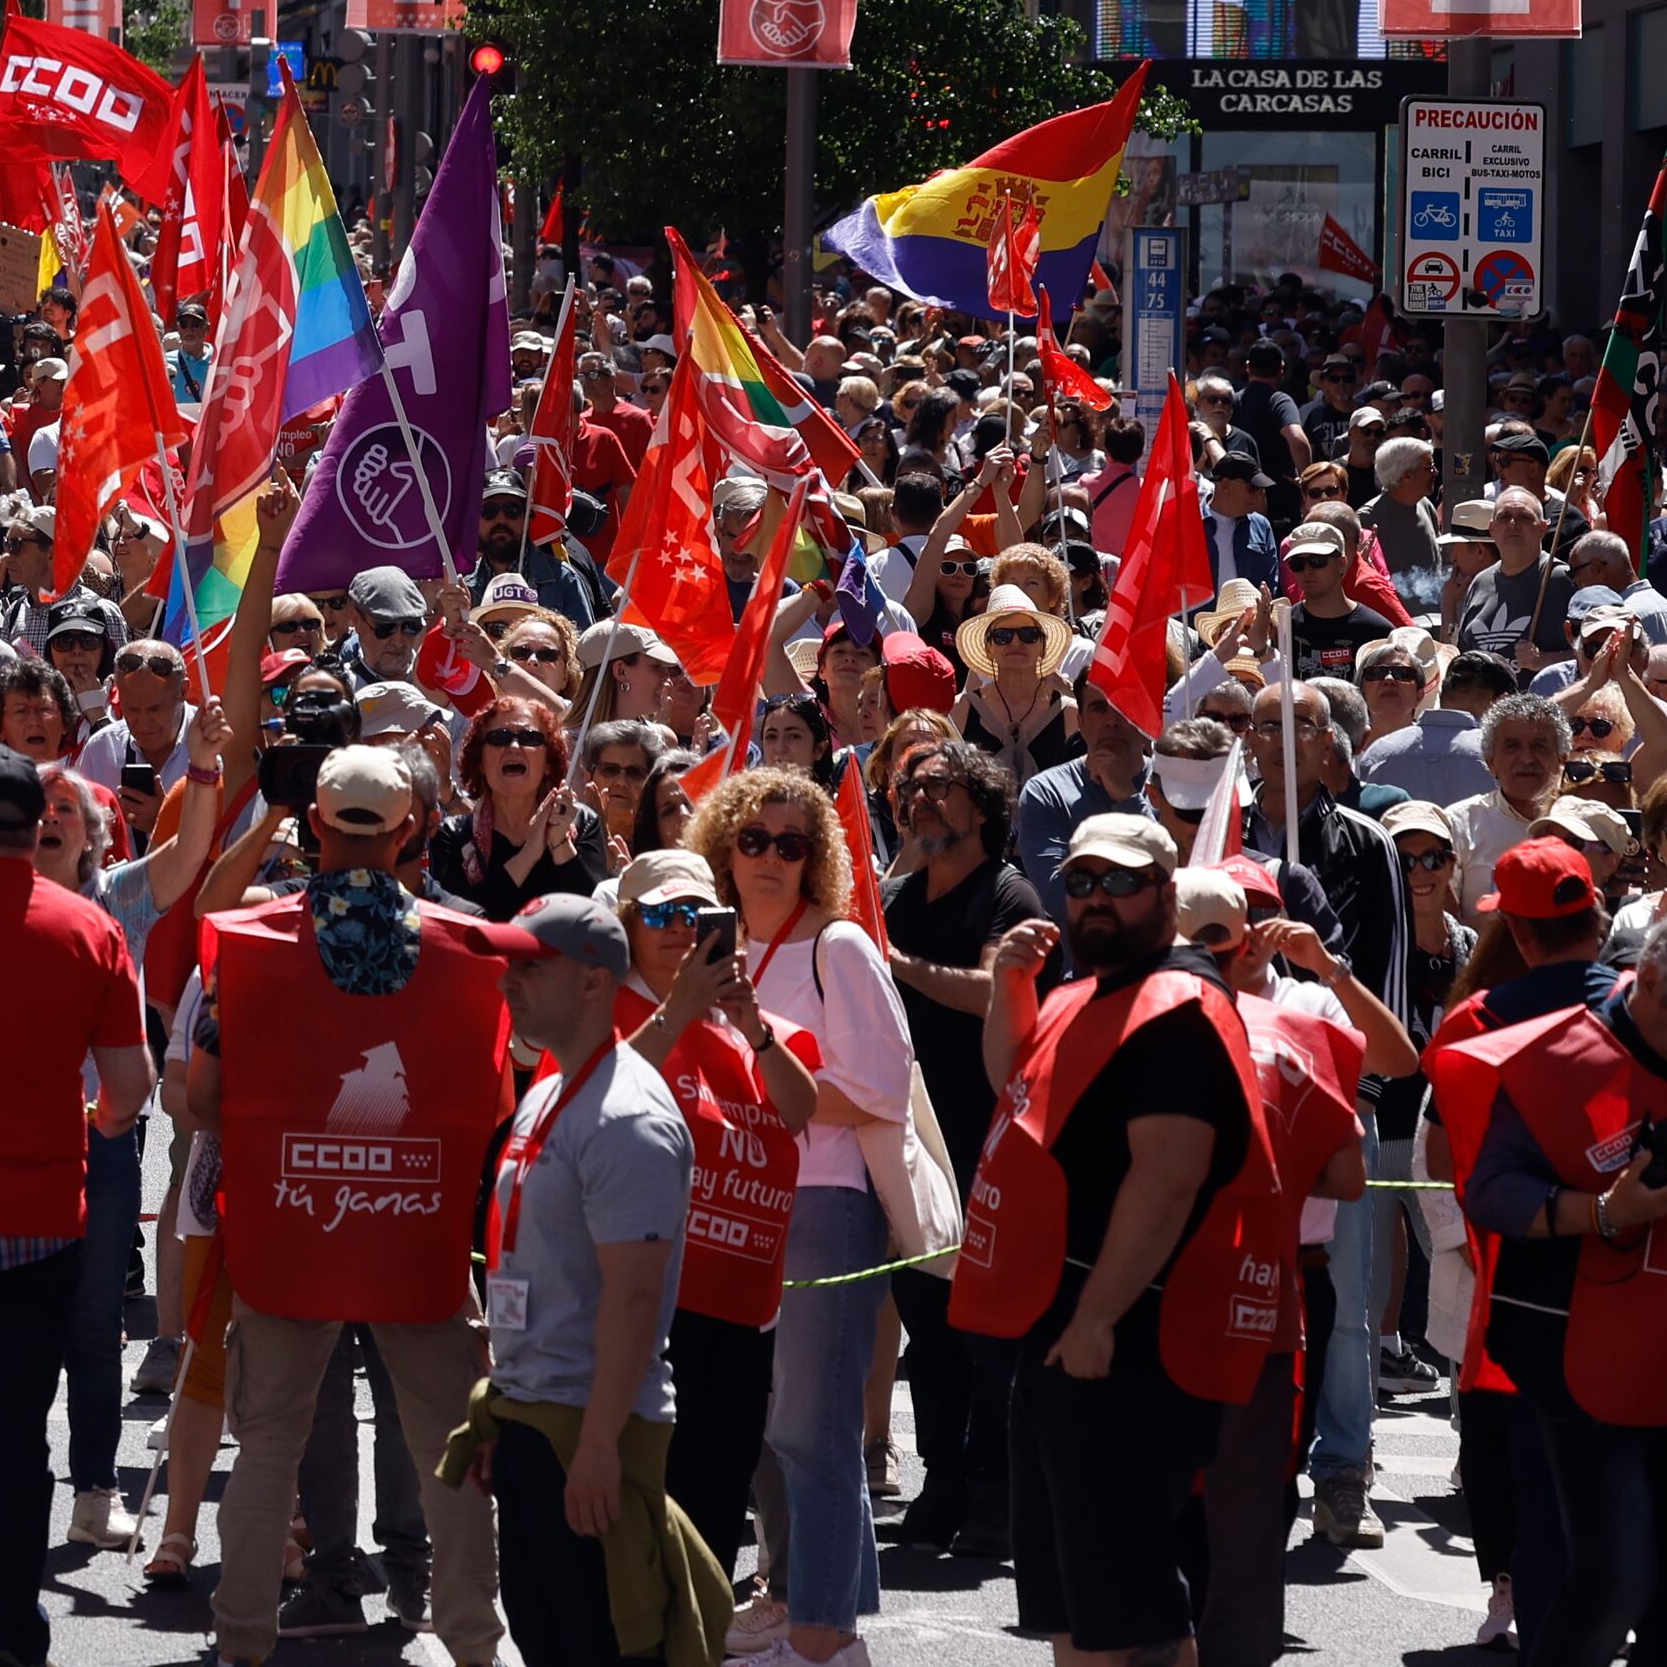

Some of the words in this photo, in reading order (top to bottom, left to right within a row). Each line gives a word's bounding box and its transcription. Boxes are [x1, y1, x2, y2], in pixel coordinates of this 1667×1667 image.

[1193, 71, 1224, 88] LA
[1228, 70, 1292, 88] CASA
[1296, 70, 1328, 88] DE
[1332, 70, 1384, 89] LAS
[0, 55, 144, 133] CCOO
[1220, 95, 1354, 114] CARCASAS
[1415, 108, 1538, 132] PRECAUCIÓN
[1411, 147, 1462, 161] CARRIL
[1491, 144, 1523, 155] CARRIL
[1483, 156, 1531, 168] EXCLUSIVO
[1422, 166, 1452, 179] BICI
[1471, 168, 1542, 180] BUS-TAXI-MOTOS
[1494, 228, 1516, 239] TAXI
[1148, 271, 1167, 288] 44
[1148, 292, 1165, 309] 75
[493, 586, 524, 601] UGT
[1322, 649, 1350, 659] CCOO
[291, 1142, 393, 1173] CCOO
[689, 1165, 719, 1204] ay
[273, 1180, 316, 1216] tú
[323, 1186, 443, 1233] ganas
[687, 1210, 749, 1248] COO
